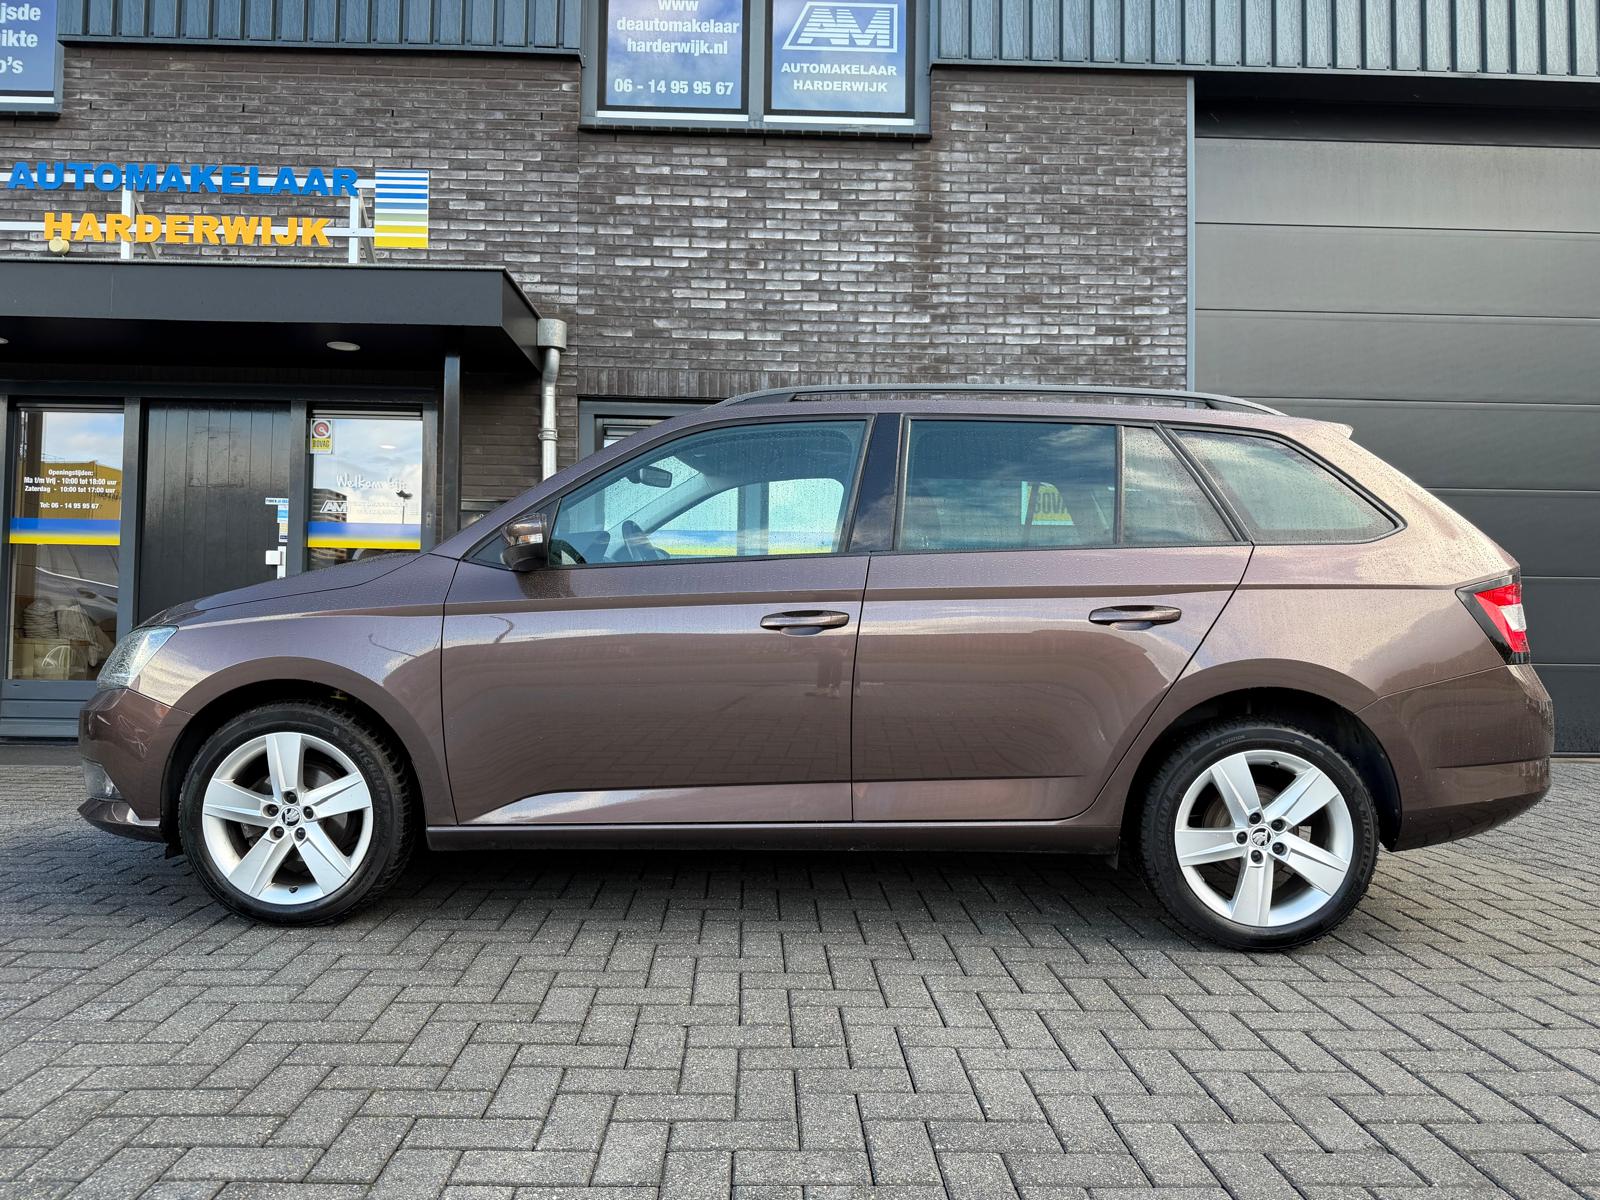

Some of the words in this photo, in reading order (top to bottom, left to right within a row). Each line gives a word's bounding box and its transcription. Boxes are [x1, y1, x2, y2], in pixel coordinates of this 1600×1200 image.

[616, 17, 739, 33] deautomakelaar
[627, 38, 728, 56] harderwijk.nl
[781, 62, 897, 76] AUTOMAKELAAR
[614, 78, 633, 93] 06
[648, 79, 666, 94] 14
[670, 80, 689, 94] 95
[693, 81, 712, 95] 95
[715, 81, 734, 95] 67
[793, 79, 888, 92] HARDERWIJK
[7, 161, 360, 197] AUTOMAKELAAR
[43, 211, 331, 247] HARDERWIJK
[311, 439, 331, 449] BOVAG
[48, 469, 94, 477] Openingstijden:
[62, 477, 78, 485] 10:00
[24, 485, 51, 494] Zaterdag
[82, 502, 90, 510] 95
